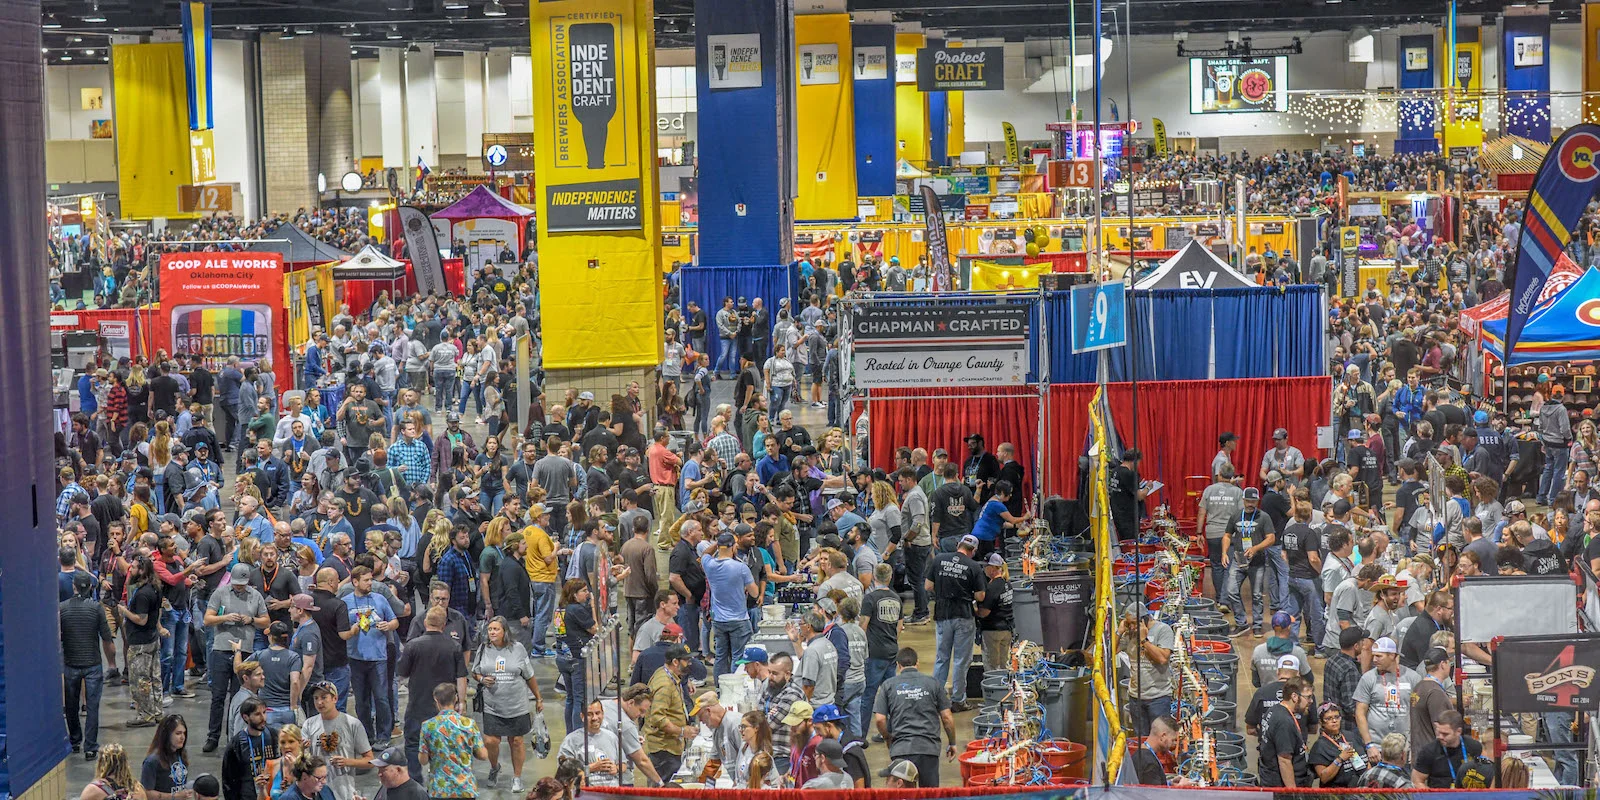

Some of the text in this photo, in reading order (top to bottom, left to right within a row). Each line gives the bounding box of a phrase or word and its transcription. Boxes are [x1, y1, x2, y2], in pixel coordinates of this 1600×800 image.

[568, 12, 615, 20] CERTIFIED
[571, 43, 608, 61] INDE
[730, 47, 759, 56] INDEPEN
[730, 55, 753, 63] DENCE
[935, 51, 985, 64] Protect
[572, 61, 604, 78] PEN
[935, 64, 985, 80] CRAFT
[556, 24, 569, 160] BREWERS ASSOCIATION
[572, 78, 614, 95] DENT
[573, 95, 611, 107] CRAFT
[1070, 162, 1089, 185] 13
[200, 188, 219, 209] 12
[552, 190, 637, 206] INDEPENDENCE
[587, 206, 637, 221] MATTERS
[1414, 200, 1427, 217] TW
[168, 259, 277, 270] COOP ALE WORKS
[190, 271, 254, 281] Oklahoma City
[1179, 270, 1218, 289] EV
[1096, 291, 1108, 340] 9
[858, 318, 1021, 334] CHAPMAN CRAFTED
[864, 355, 1005, 373] Rooted in Orange County
[1479, 435, 1499, 445] BEER
[955, 563, 969, 571] CREW
[1065, 583, 1082, 591] ONLY
[1532, 670, 1589, 690] SONS
[1541, 645, 1580, 708] 4
[1536, 694, 1557, 702] BREWING
